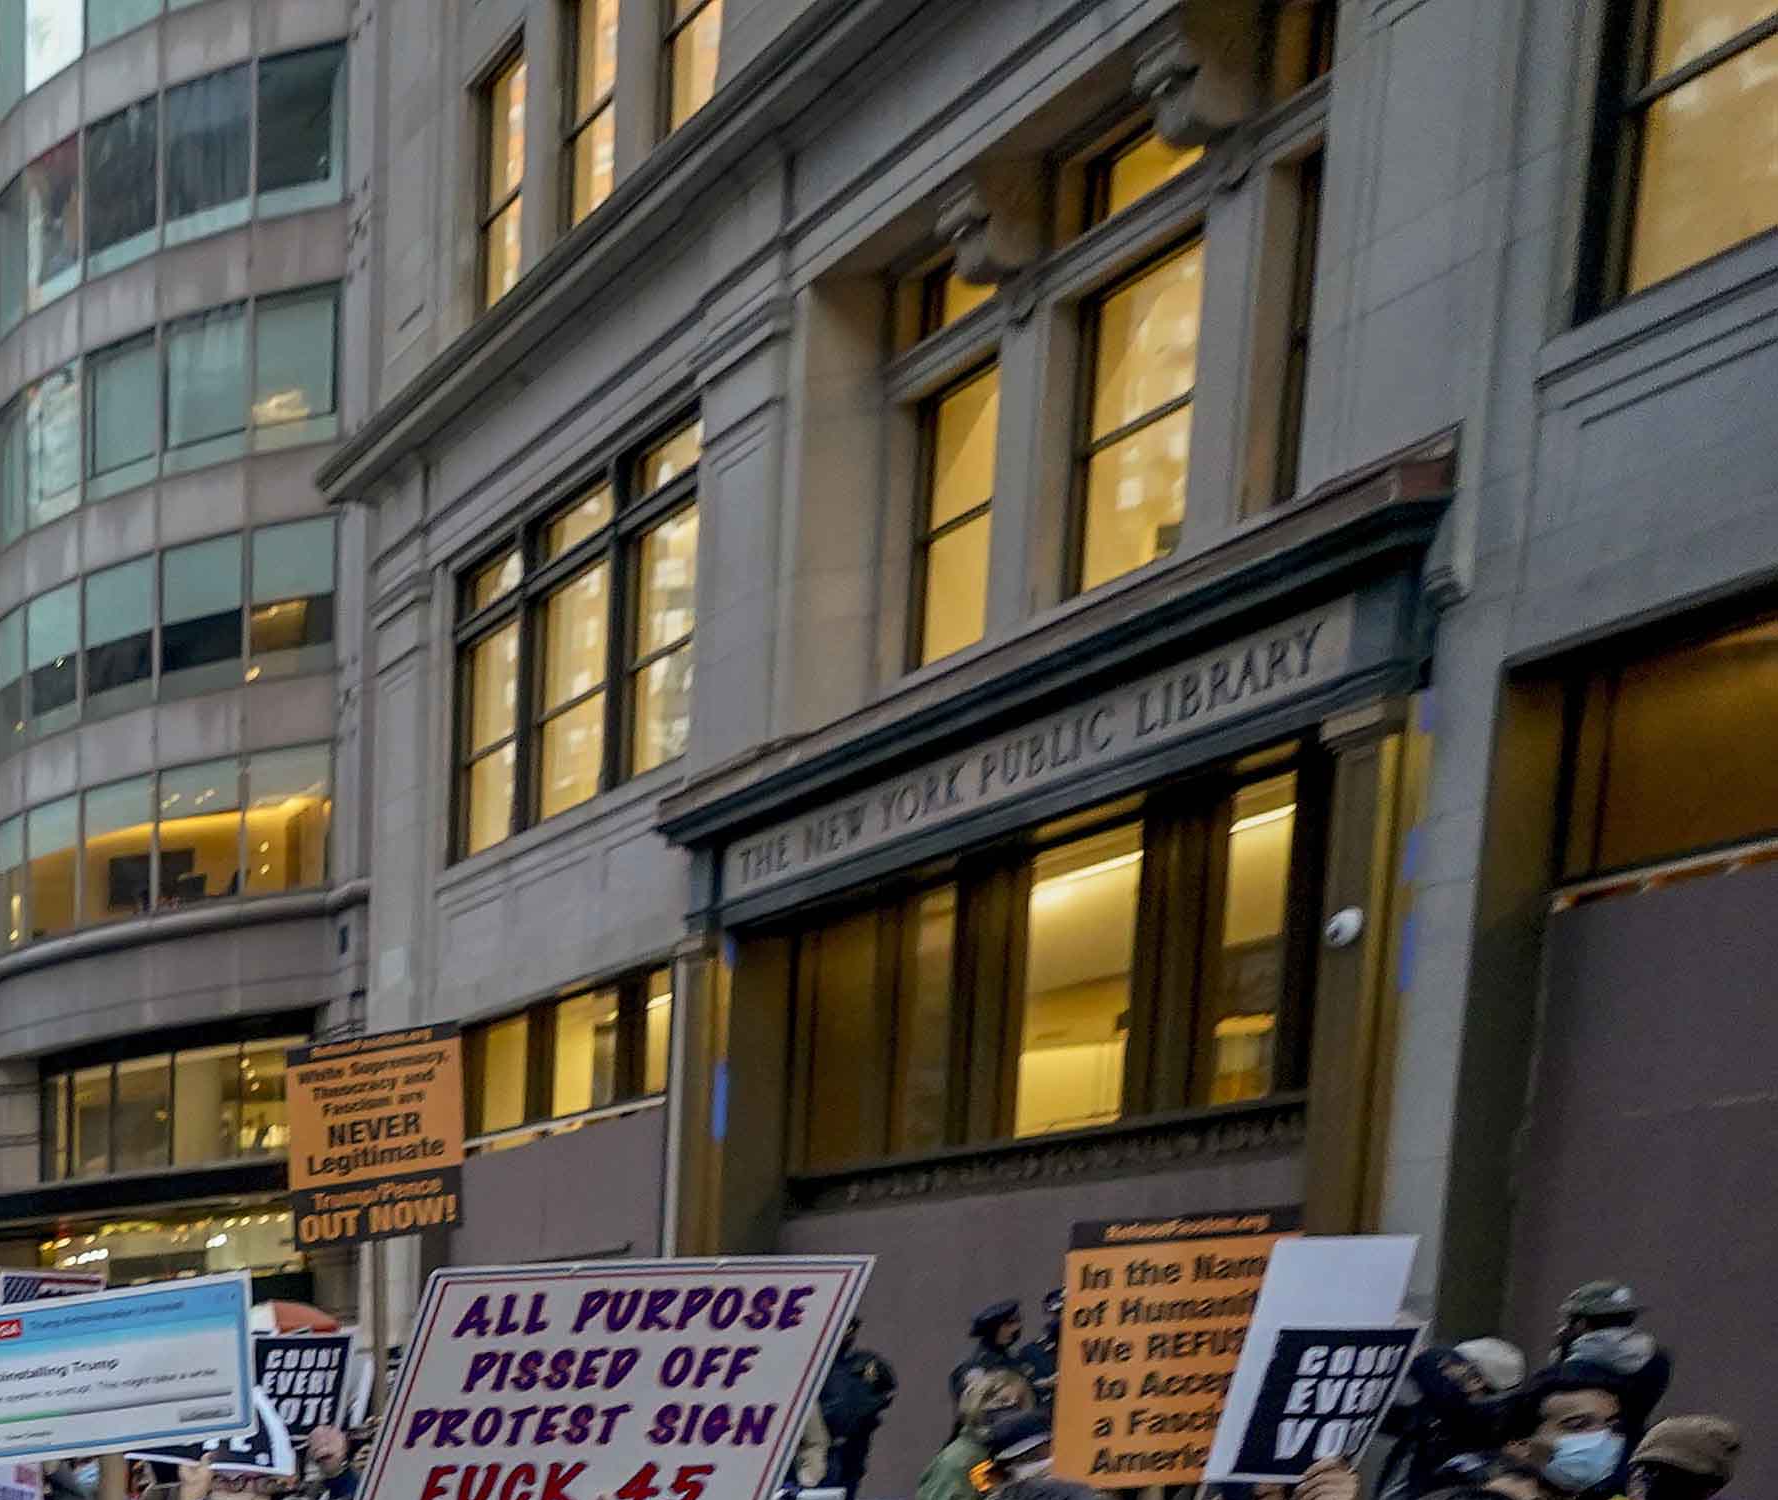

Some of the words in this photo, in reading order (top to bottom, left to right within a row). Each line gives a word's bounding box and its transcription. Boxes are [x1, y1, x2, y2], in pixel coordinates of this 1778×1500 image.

[740, 842, 788, 884] THE
[804, 815, 865, 864] NEW
[877, 765, 965, 834] YORK
[979, 709, 1113, 797] PUBLIC
[1135, 622, 1325, 741] LIBRARY
[329, 1112, 421, 1148] NEVER
[308, 1138, 446, 1176] Legitimate
[299, 1210, 361, 1243] OUT
[370, 1194, 457, 1233] NOW!
[1080, 1263, 1113, 1291] In
[1125, 1259, 1181, 1285] the
[452, 1293, 548, 1337] ALL
[573, 1286, 815, 1334] PURPOSE
[1072, 1301, 1108, 1329] of
[266, 1348, 341, 1369] COUNT
[1080, 1337, 1131, 1365] We
[263, 1370, 338, 1395] EVERY
[462, 1347, 641, 1393] PISSED
[660, 1346, 759, 1388] OFF
[1093, 1376, 1128, 1400] to
[404, 1403, 632, 1448] PROTEST
[647, 1403, 776, 1446] SIGN
[1093, 1417, 1113, 1436] a
